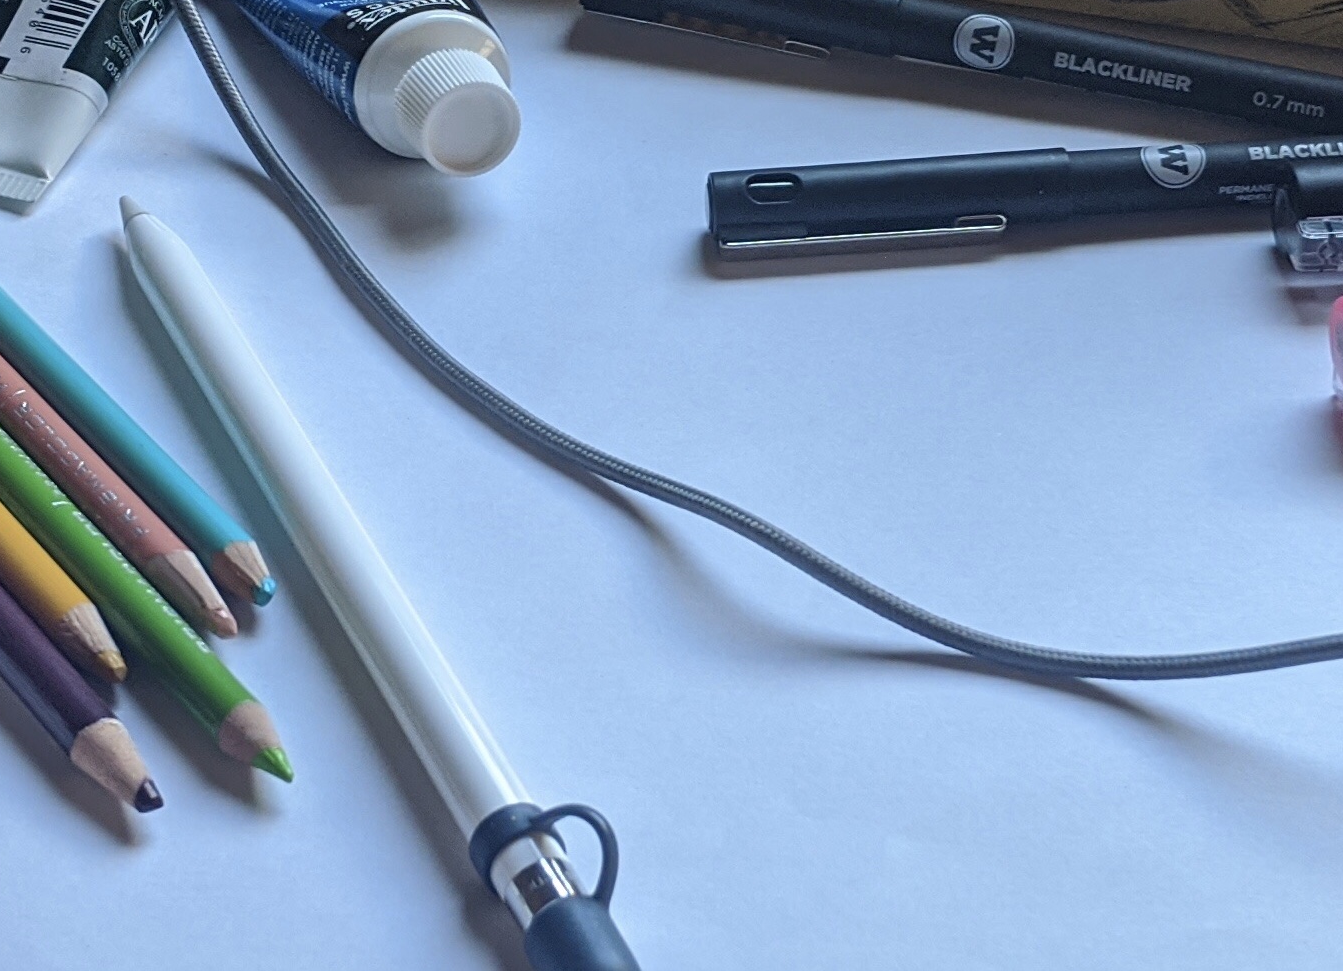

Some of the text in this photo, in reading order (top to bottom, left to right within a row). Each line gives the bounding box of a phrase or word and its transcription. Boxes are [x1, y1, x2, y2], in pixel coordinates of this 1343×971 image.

[1053, 51, 1325, 118] BLACKLINER 0.7 mm
[1218, 184, 1274, 195] PERMANE
